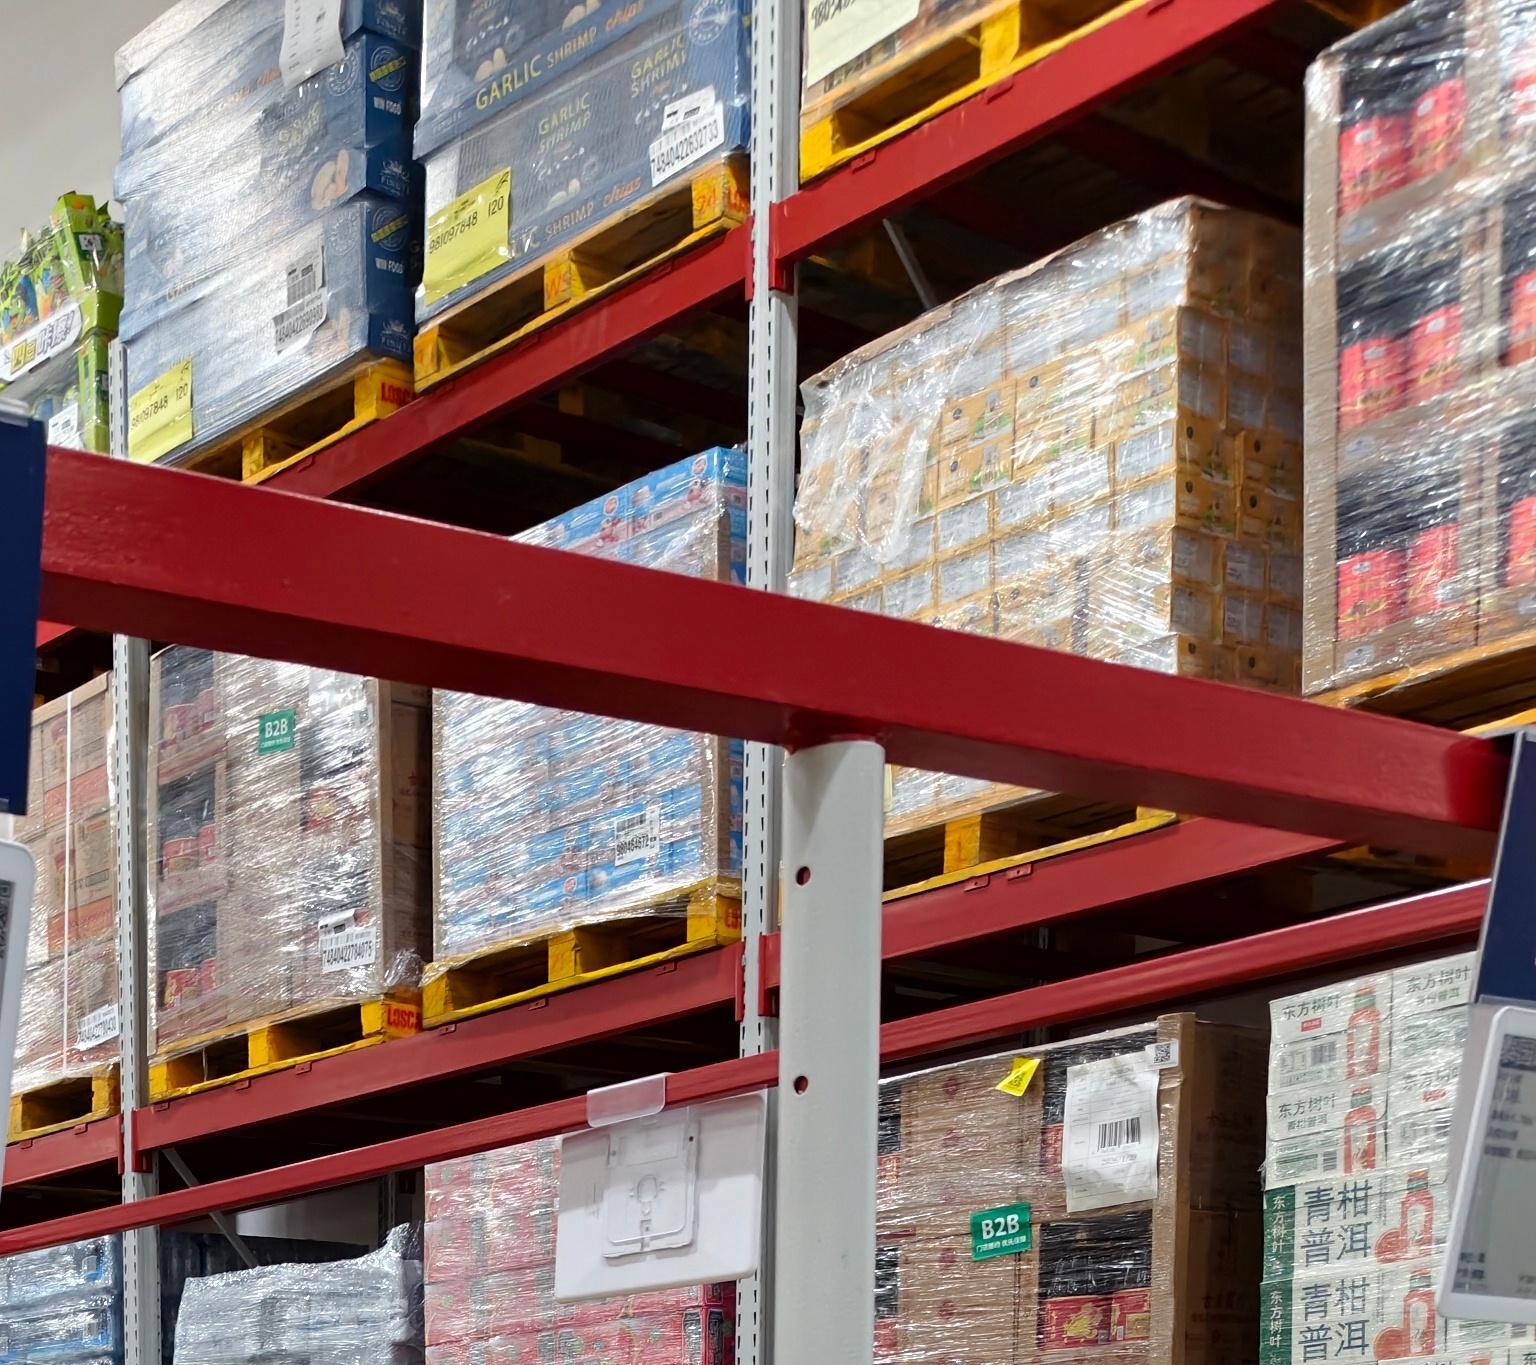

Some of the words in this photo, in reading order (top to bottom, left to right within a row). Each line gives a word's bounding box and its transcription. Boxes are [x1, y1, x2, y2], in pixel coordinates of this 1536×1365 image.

[476, 53, 542, 111] GARLIC
[547, 25, 597, 69] SHRIMP
[538, 92, 590, 136] GARLIC
[546, 202, 595, 239] SHRIMP
[264, 718, 288, 739] B2B
[1304, 1180, 1373, 1226] 青柑
[982, 1213, 1020, 1240] B2B
[1301, 1221, 1372, 1267] 普洱
[1301, 1277, 1370, 1321] 青柑
[1298, 1319, 1370, 1363] 普洱
